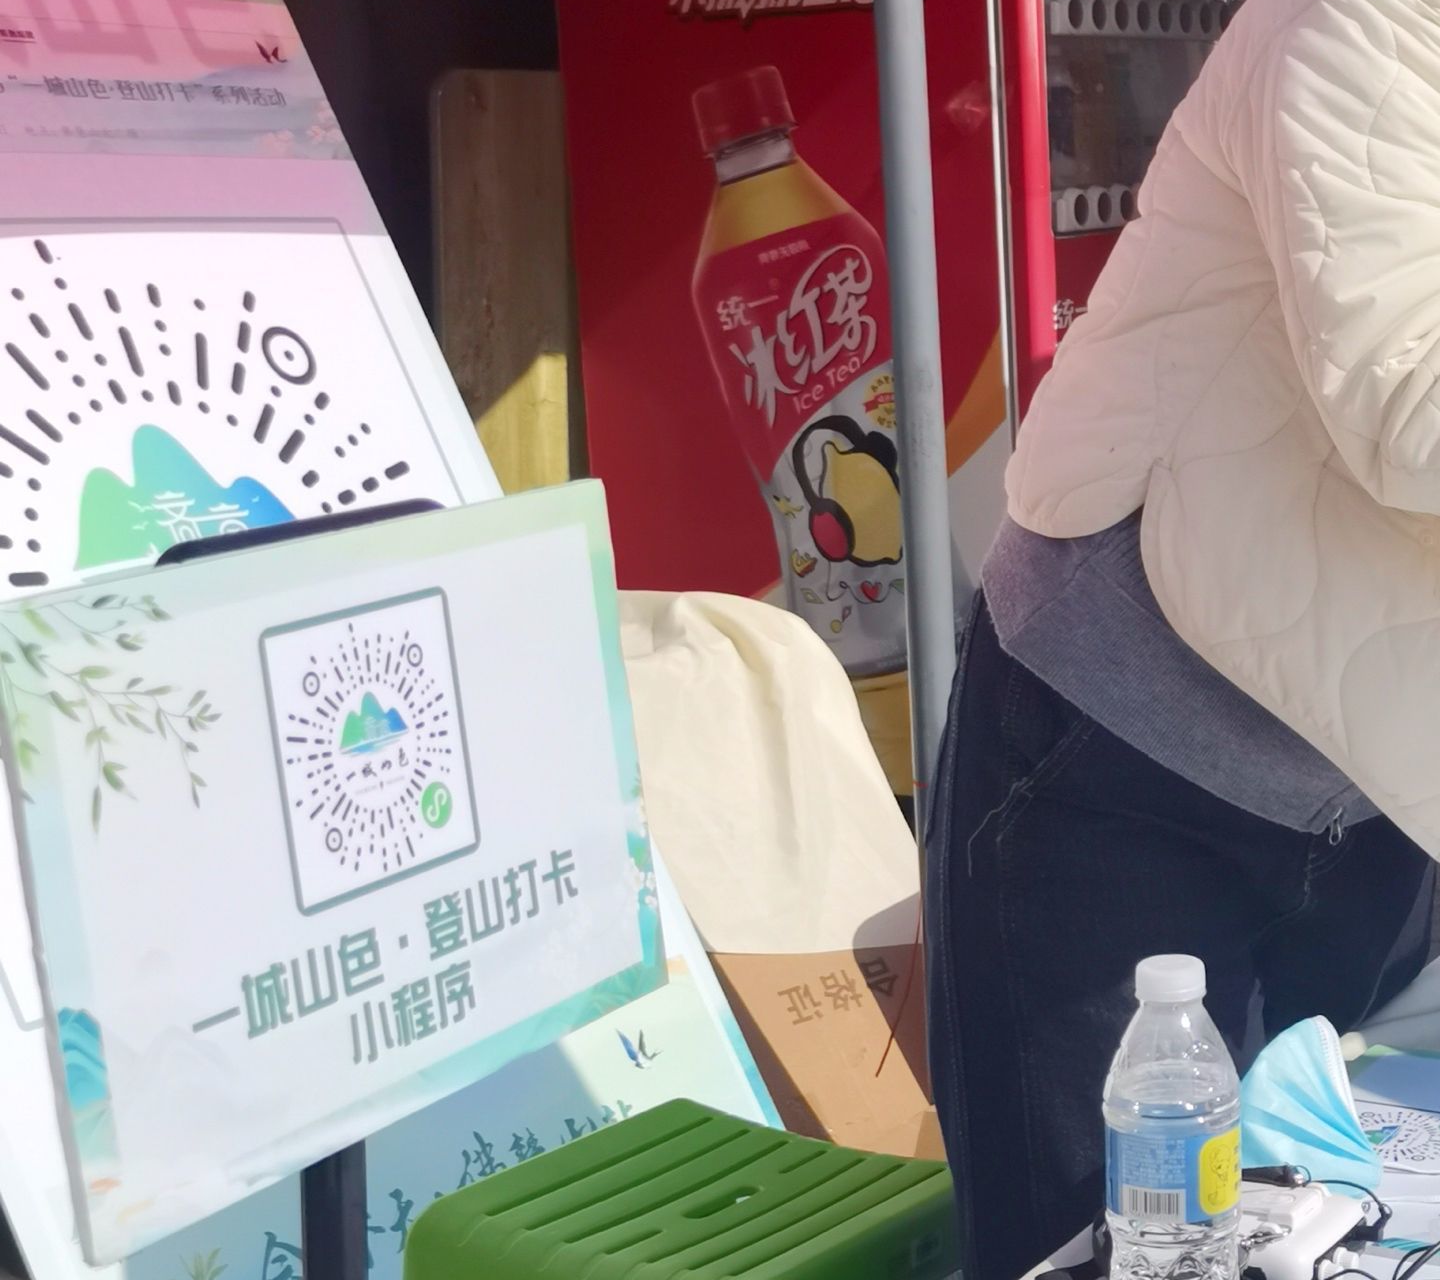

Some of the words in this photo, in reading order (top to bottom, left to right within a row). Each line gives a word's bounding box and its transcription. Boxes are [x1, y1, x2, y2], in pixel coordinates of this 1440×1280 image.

[716, 295, 780, 332] 统一
[729, 244, 877, 428] 冰红茶
[794, 383, 826, 414] Ice
[826, 353, 863, 388] Tea
[192, 847, 579, 1040] 一城山色·登山打卡
[350, 963, 478, 1065] 小程序
